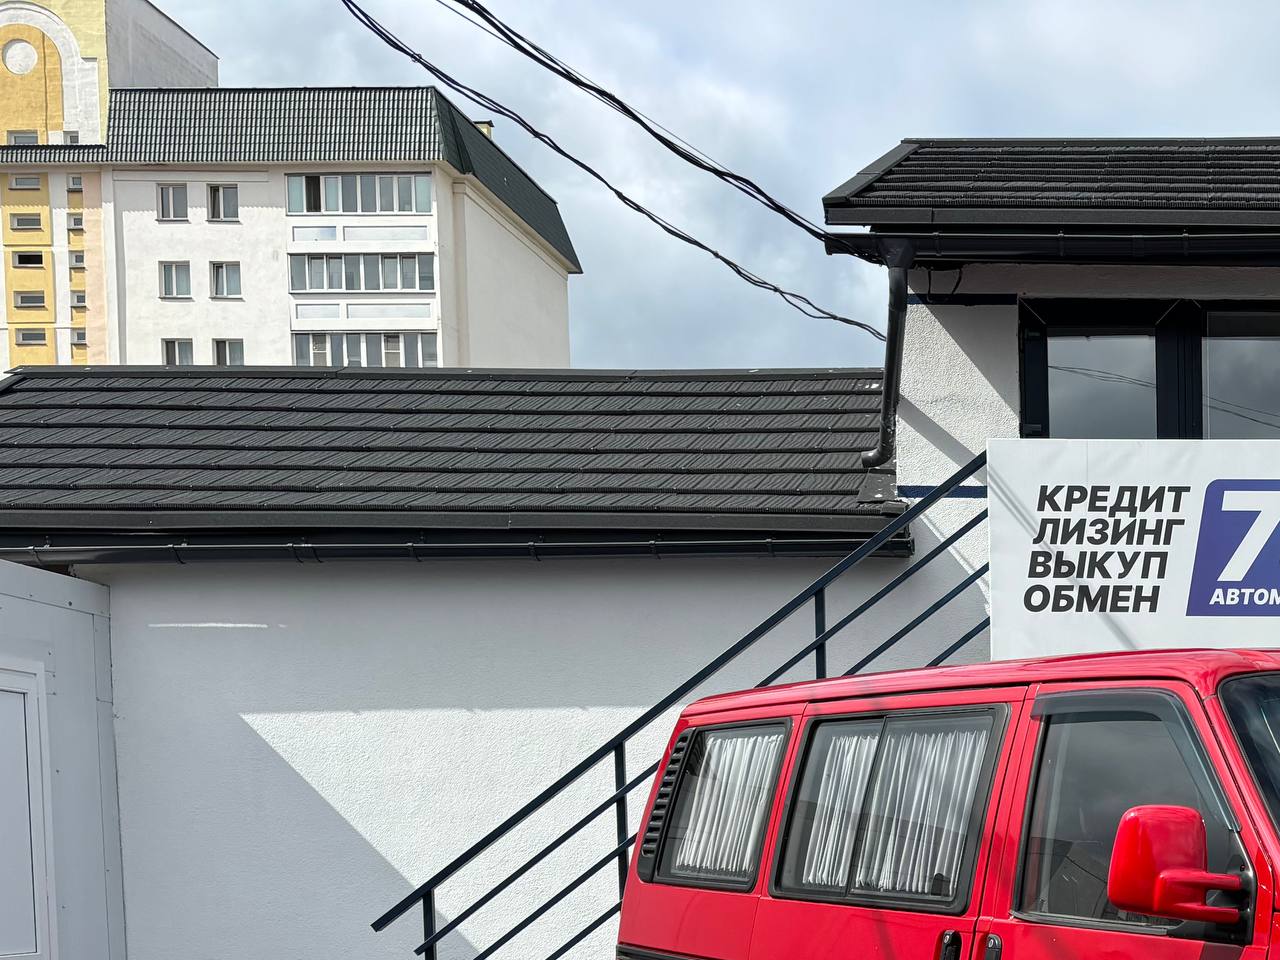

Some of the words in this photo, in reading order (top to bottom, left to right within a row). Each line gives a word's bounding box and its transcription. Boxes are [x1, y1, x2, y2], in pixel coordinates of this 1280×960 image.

[1036, 485, 1191, 518] КРЕДИТ
[1032, 518, 1185, 545] ЛИЗИНГ
[1027, 551, 1169, 579] ВЫКУП
[1023, 584, 1160, 613] ОБМЕН
